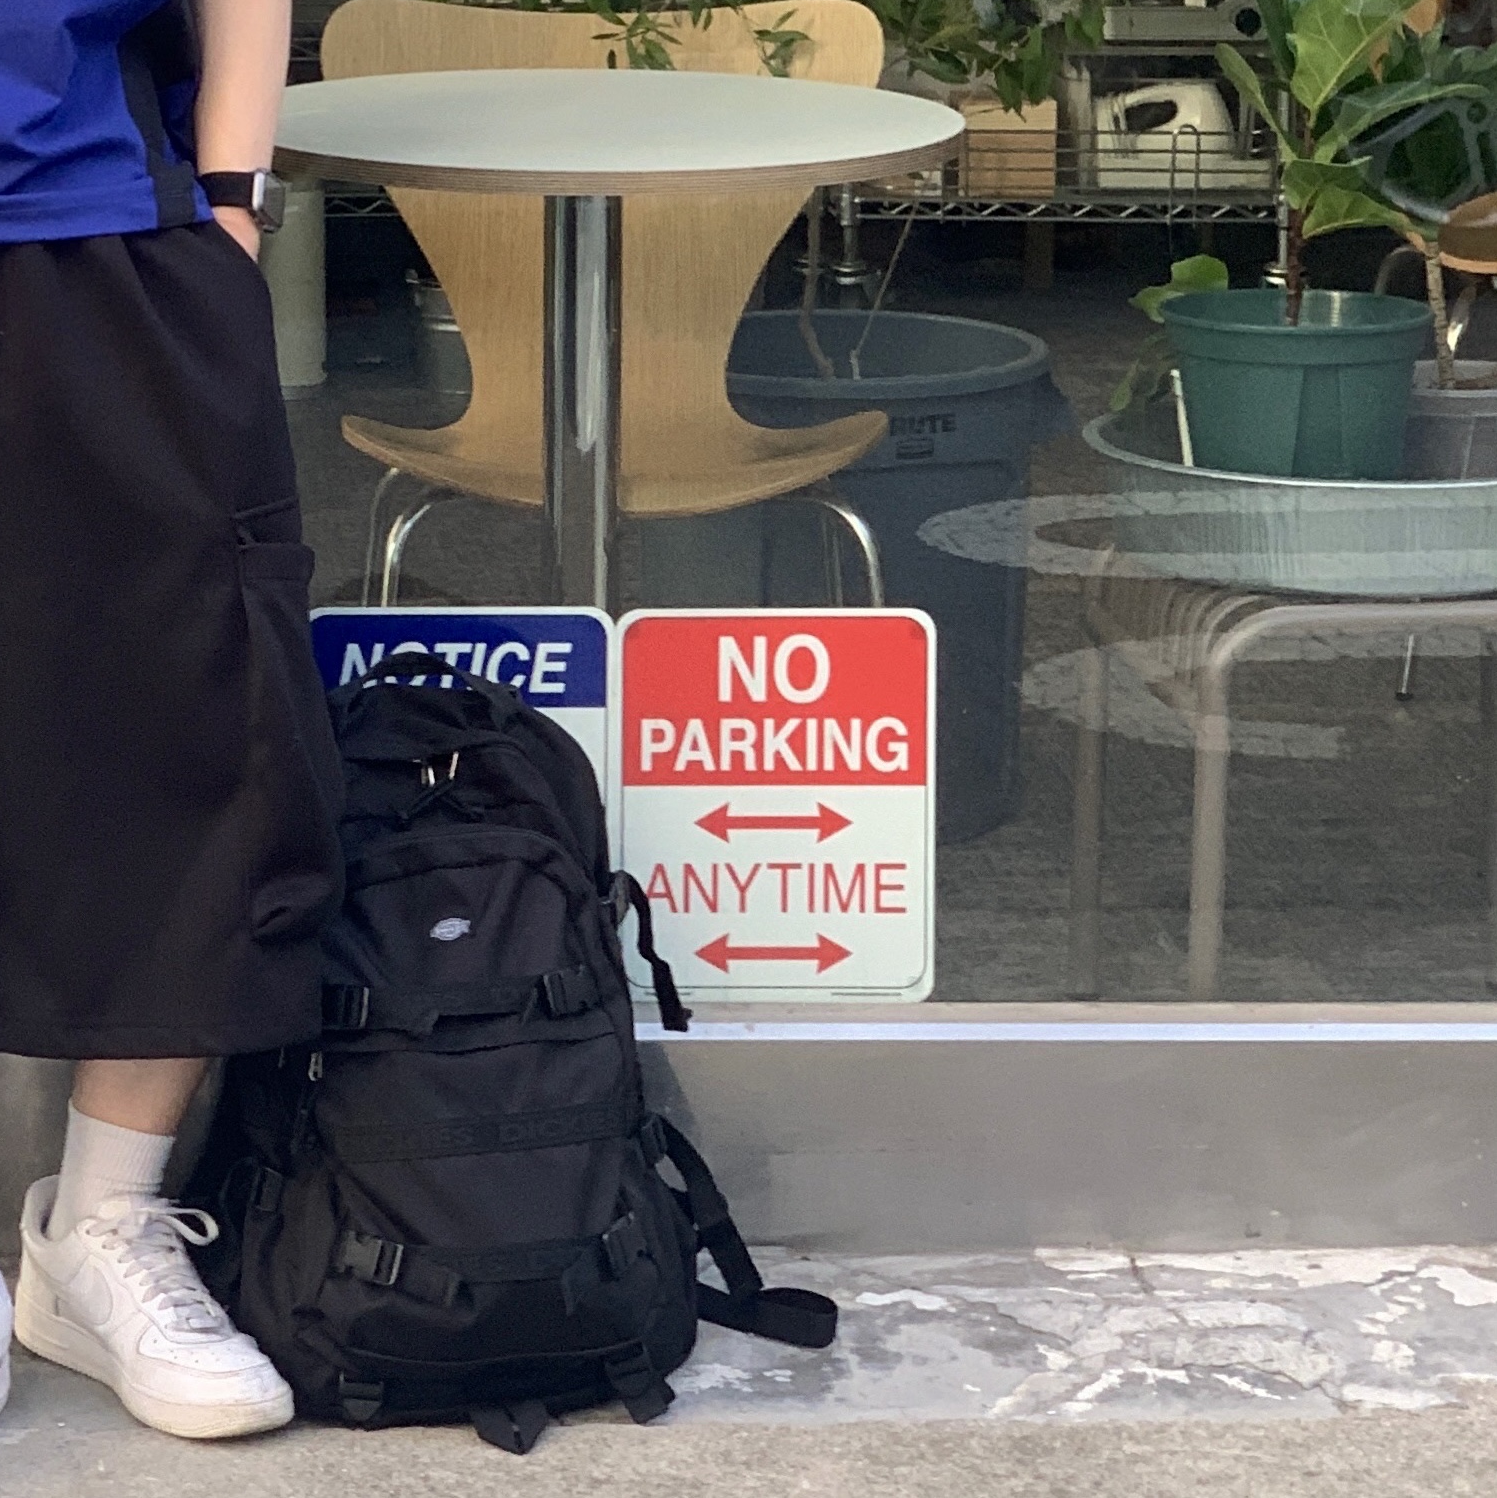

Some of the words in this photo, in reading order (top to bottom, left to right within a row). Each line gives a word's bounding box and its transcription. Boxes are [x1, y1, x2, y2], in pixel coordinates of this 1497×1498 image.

[716, 634, 831, 704] NO
[639, 716, 910, 774] PARKING
[647, 862, 907, 915] ANYTIME
